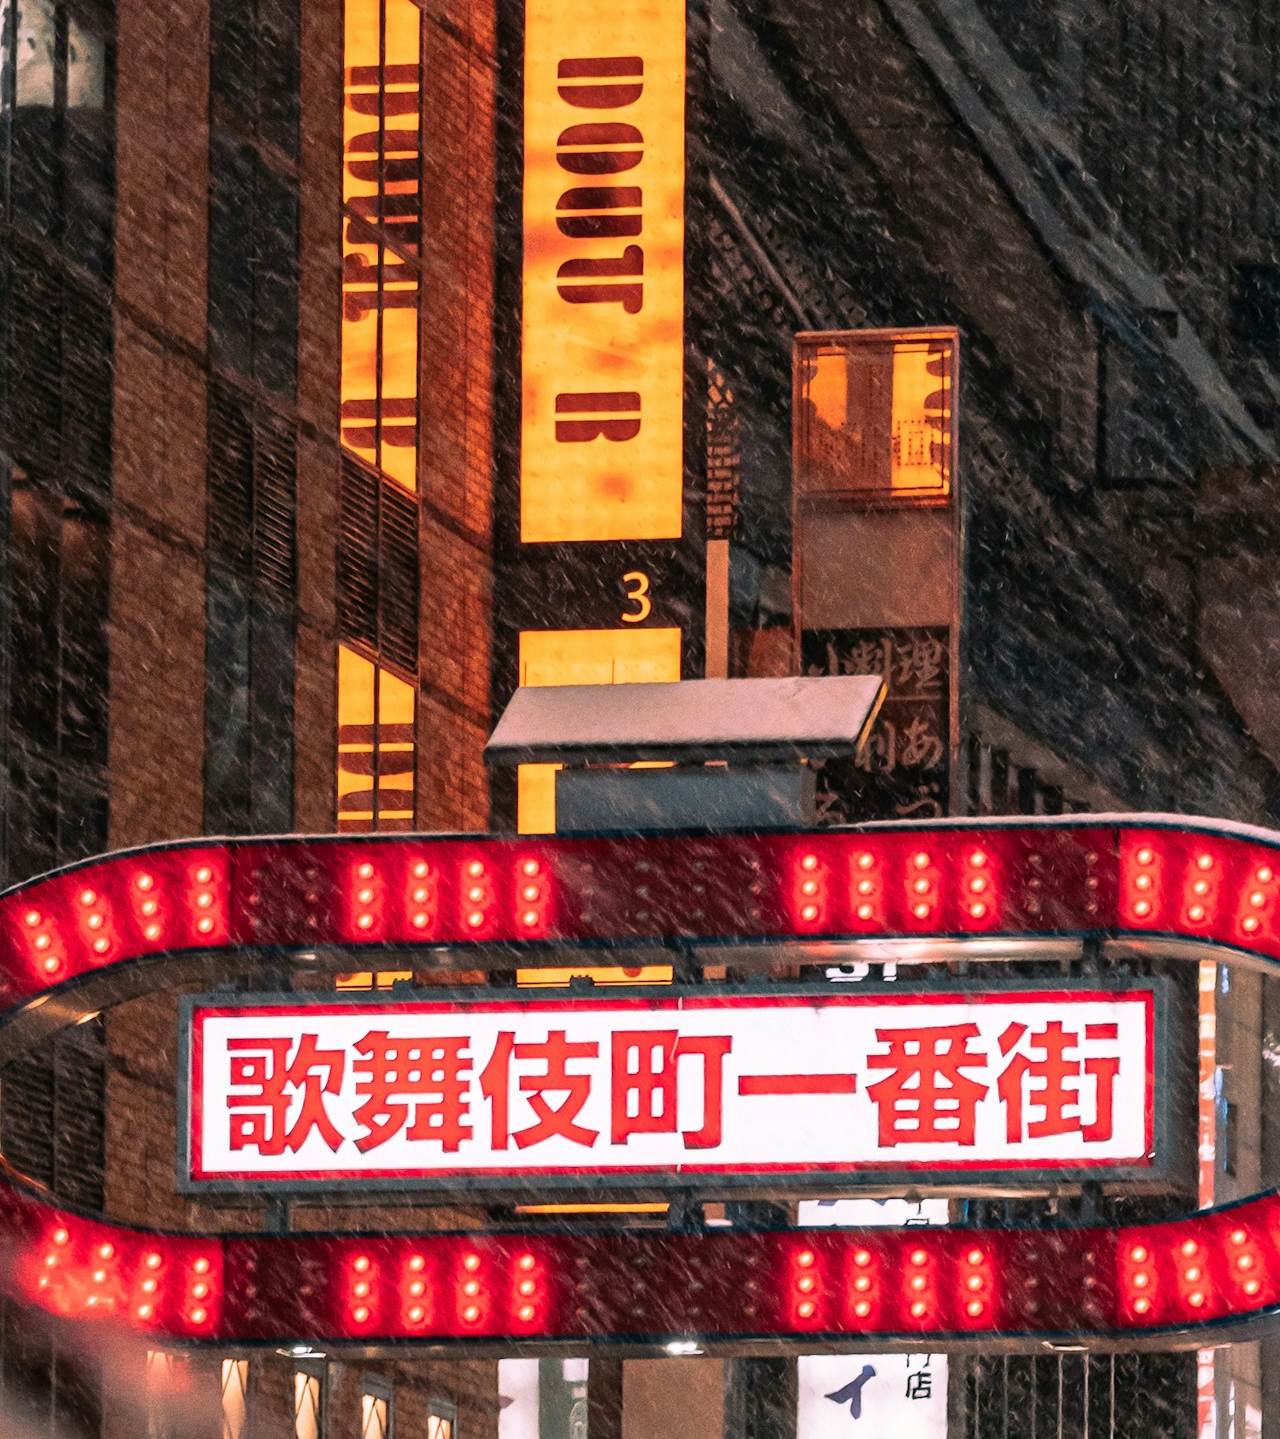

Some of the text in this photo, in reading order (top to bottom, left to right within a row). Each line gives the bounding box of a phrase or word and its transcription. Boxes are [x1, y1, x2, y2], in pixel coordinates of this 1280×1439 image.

[622, 571, 652, 623] 3
[227, 1019, 1119, 1154] 歌舞伎町一番街
